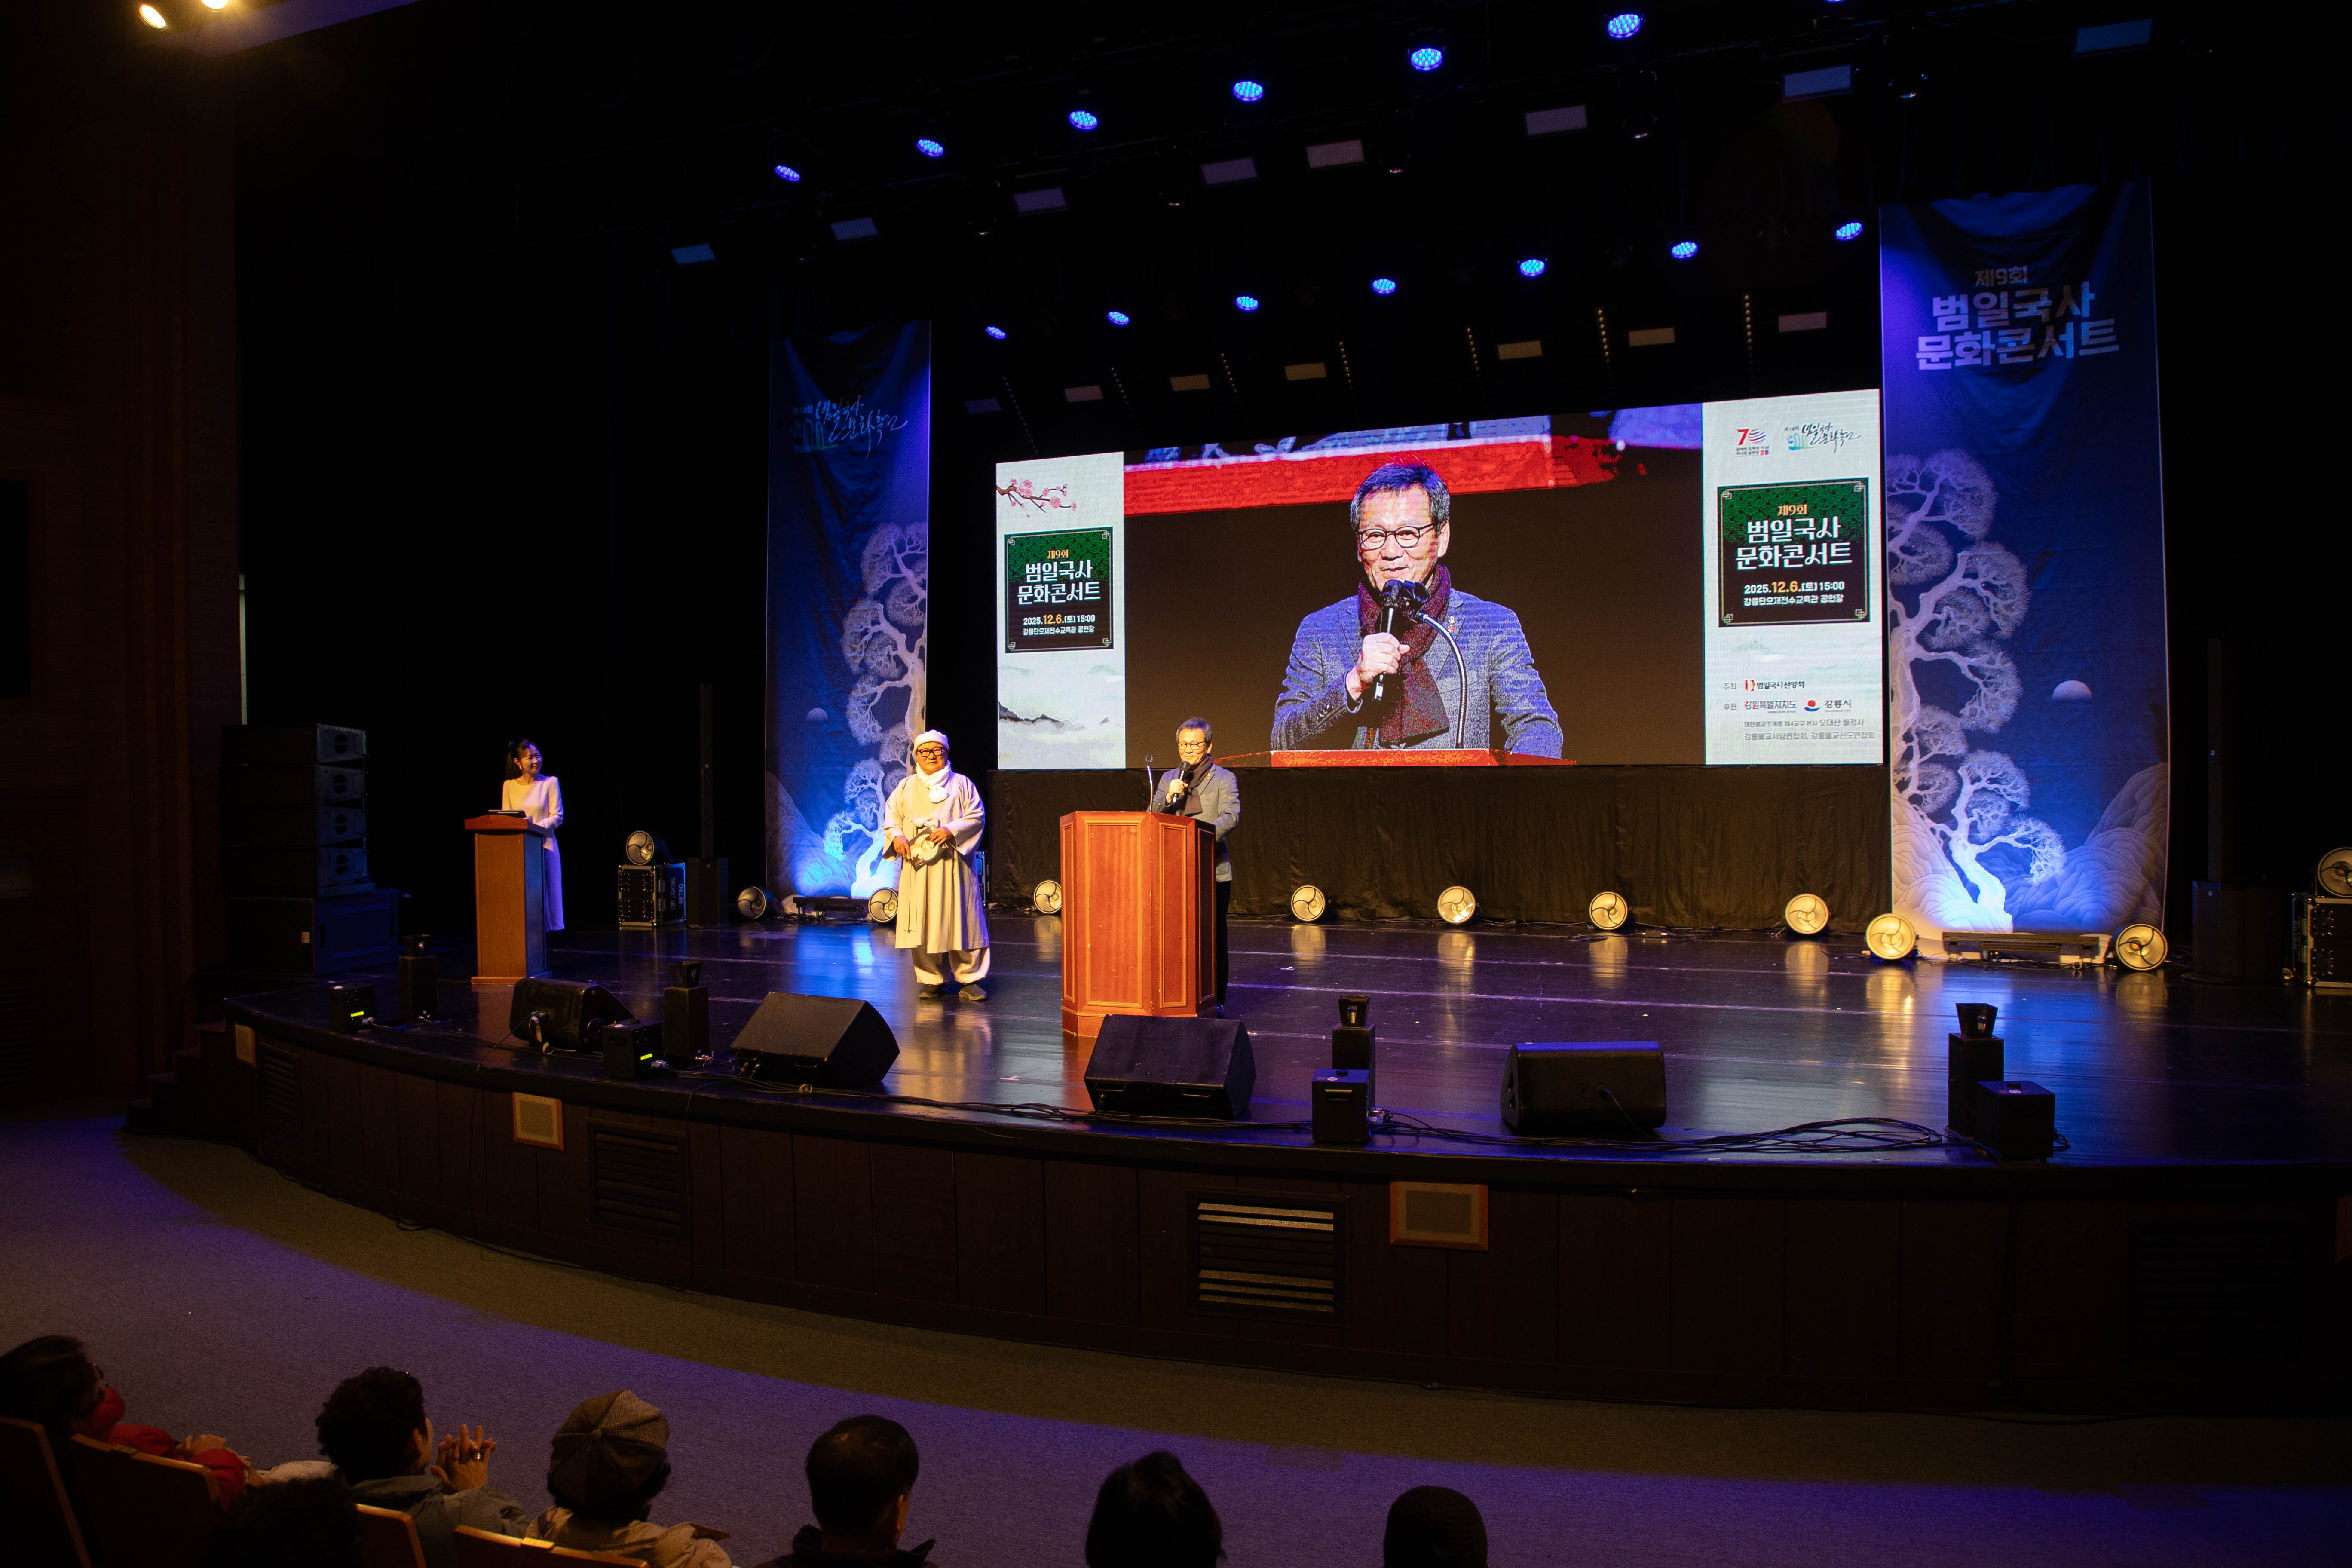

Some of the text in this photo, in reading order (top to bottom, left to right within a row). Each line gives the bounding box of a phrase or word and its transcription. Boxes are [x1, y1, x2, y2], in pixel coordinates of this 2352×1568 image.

[1974, 265, 2027, 287] 제9회
[1932, 281, 2095, 332] 범일국사
[1916, 318, 2120, 371] 문화콘서트
[1776, 504, 1808, 516] 제9회
[1747, 516, 1841, 544] 범일국사
[1047, 549, 1069, 559] 제9회
[1736, 542, 1853, 570] 문화콘서트
[1025, 559, 1093, 582] 범일국사
[1017, 581, 1101, 605] 문화콘서트
[1819, 581, 1845, 591] 15:00
[1743, 594, 1844, 606] 강릉단오제전수교육관 공연장
[1076, 614, 1096, 622] 15:00
[1023, 625, 1095, 636] 강릉단오제전수교육관 공연장
[1825, 699, 1852, 709] 강릉시
